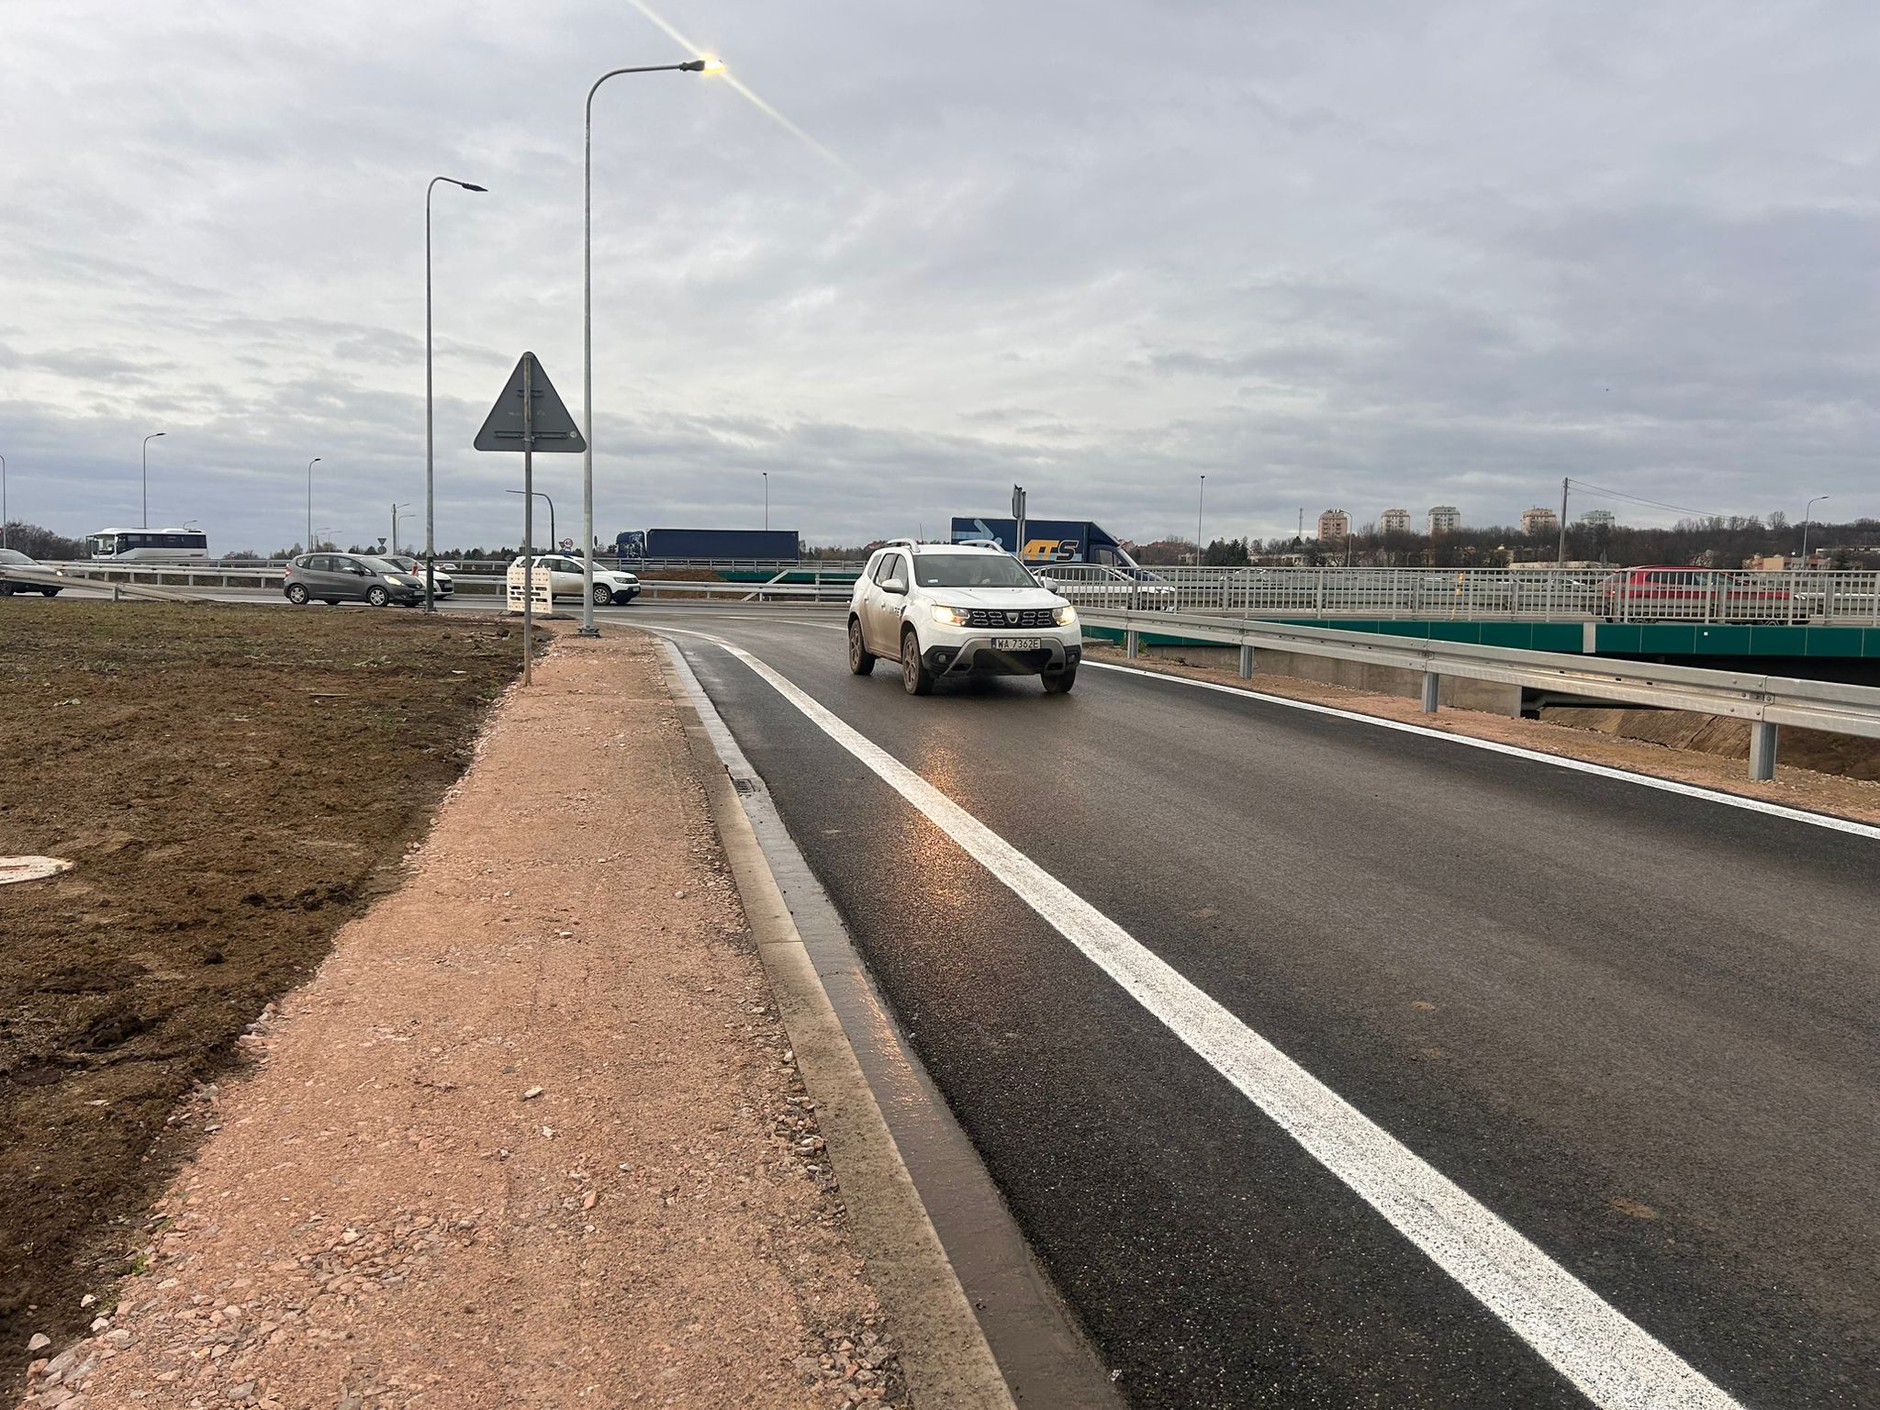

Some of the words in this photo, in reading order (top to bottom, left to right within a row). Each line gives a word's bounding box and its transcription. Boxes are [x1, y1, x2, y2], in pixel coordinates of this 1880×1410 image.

[1020, 539, 1079, 562] ATS
[997, 639, 1010, 648] WA
[1012, 639, 1039, 648] 7362E
